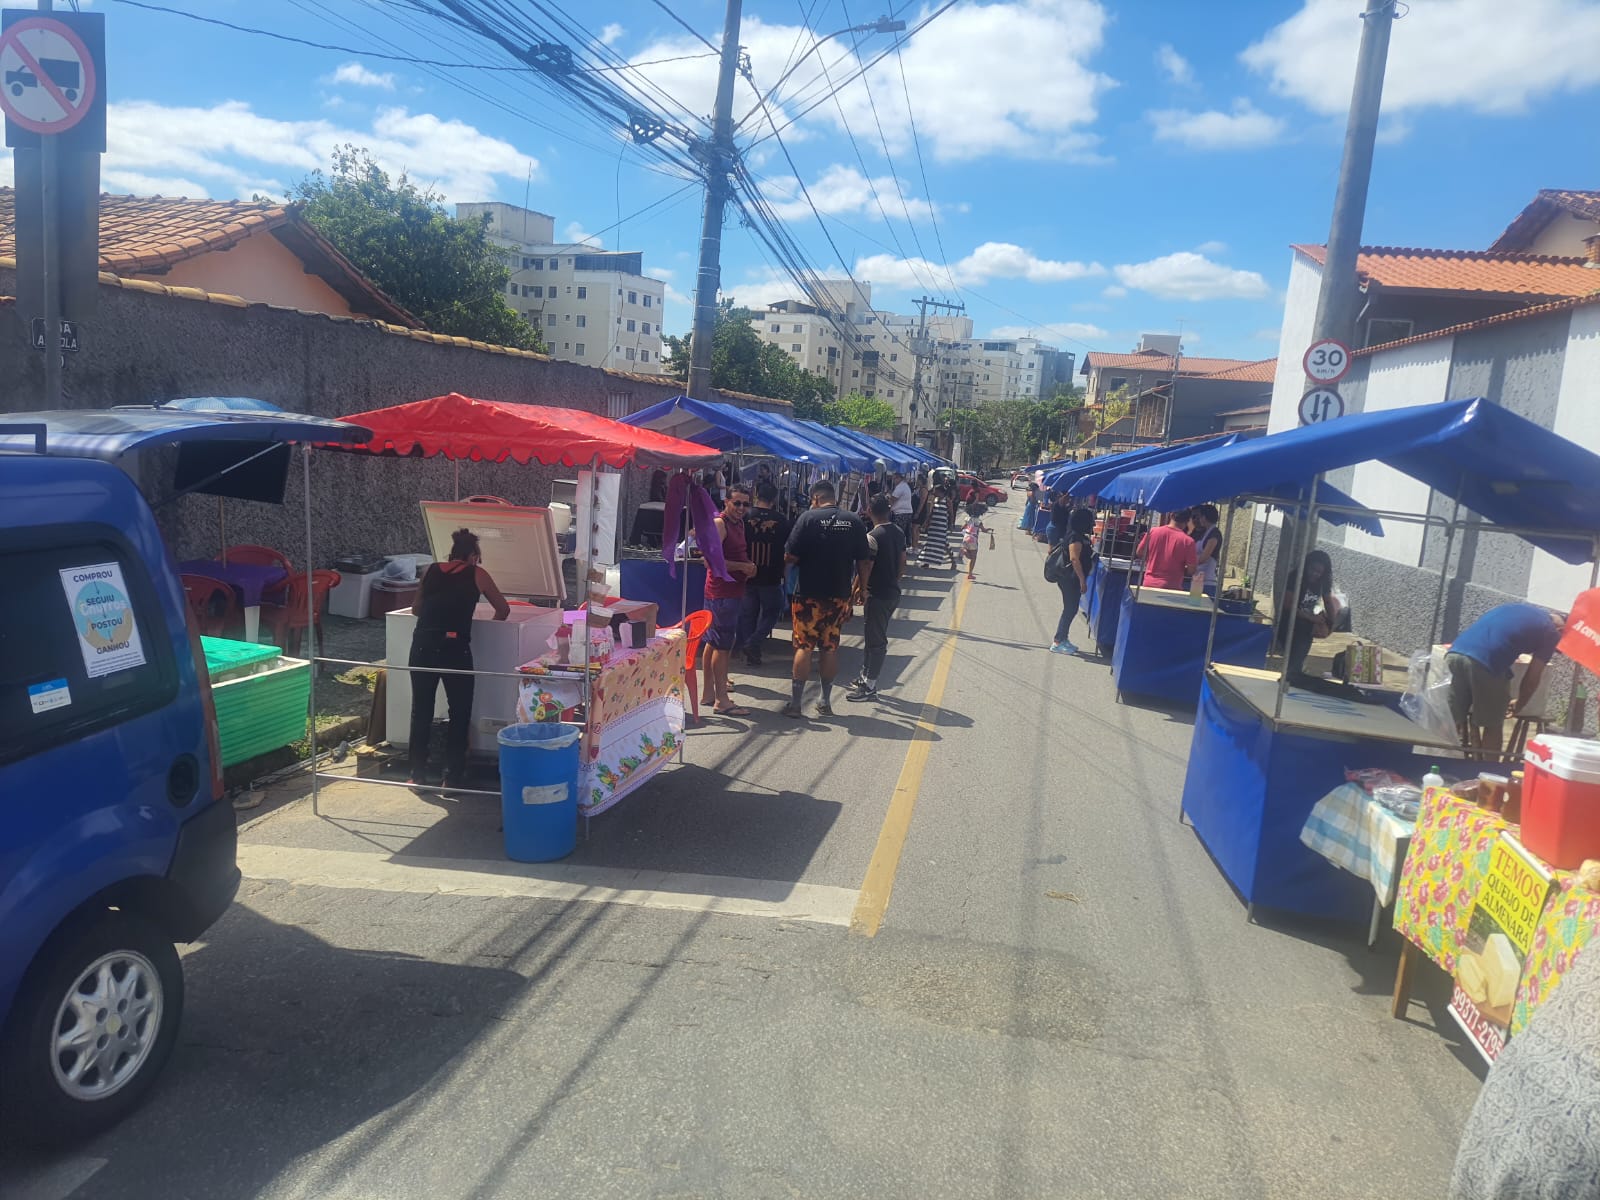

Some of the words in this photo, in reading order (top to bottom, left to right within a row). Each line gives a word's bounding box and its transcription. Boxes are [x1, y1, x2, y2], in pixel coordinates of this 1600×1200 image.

[1312, 349, 1343, 366] 30
[73, 570, 113, 582] COMPROU
[86, 594, 115, 606] SEGUIU
[91, 617, 123, 631] POSTOU
[96, 640, 130, 655] GANHOU
[1496, 847, 1541, 907] TEMOS
[1487, 873, 1520, 912] QUEIJO
[1520, 905, 1536, 929] DE
[1481, 891, 1529, 949] ALMENARA
